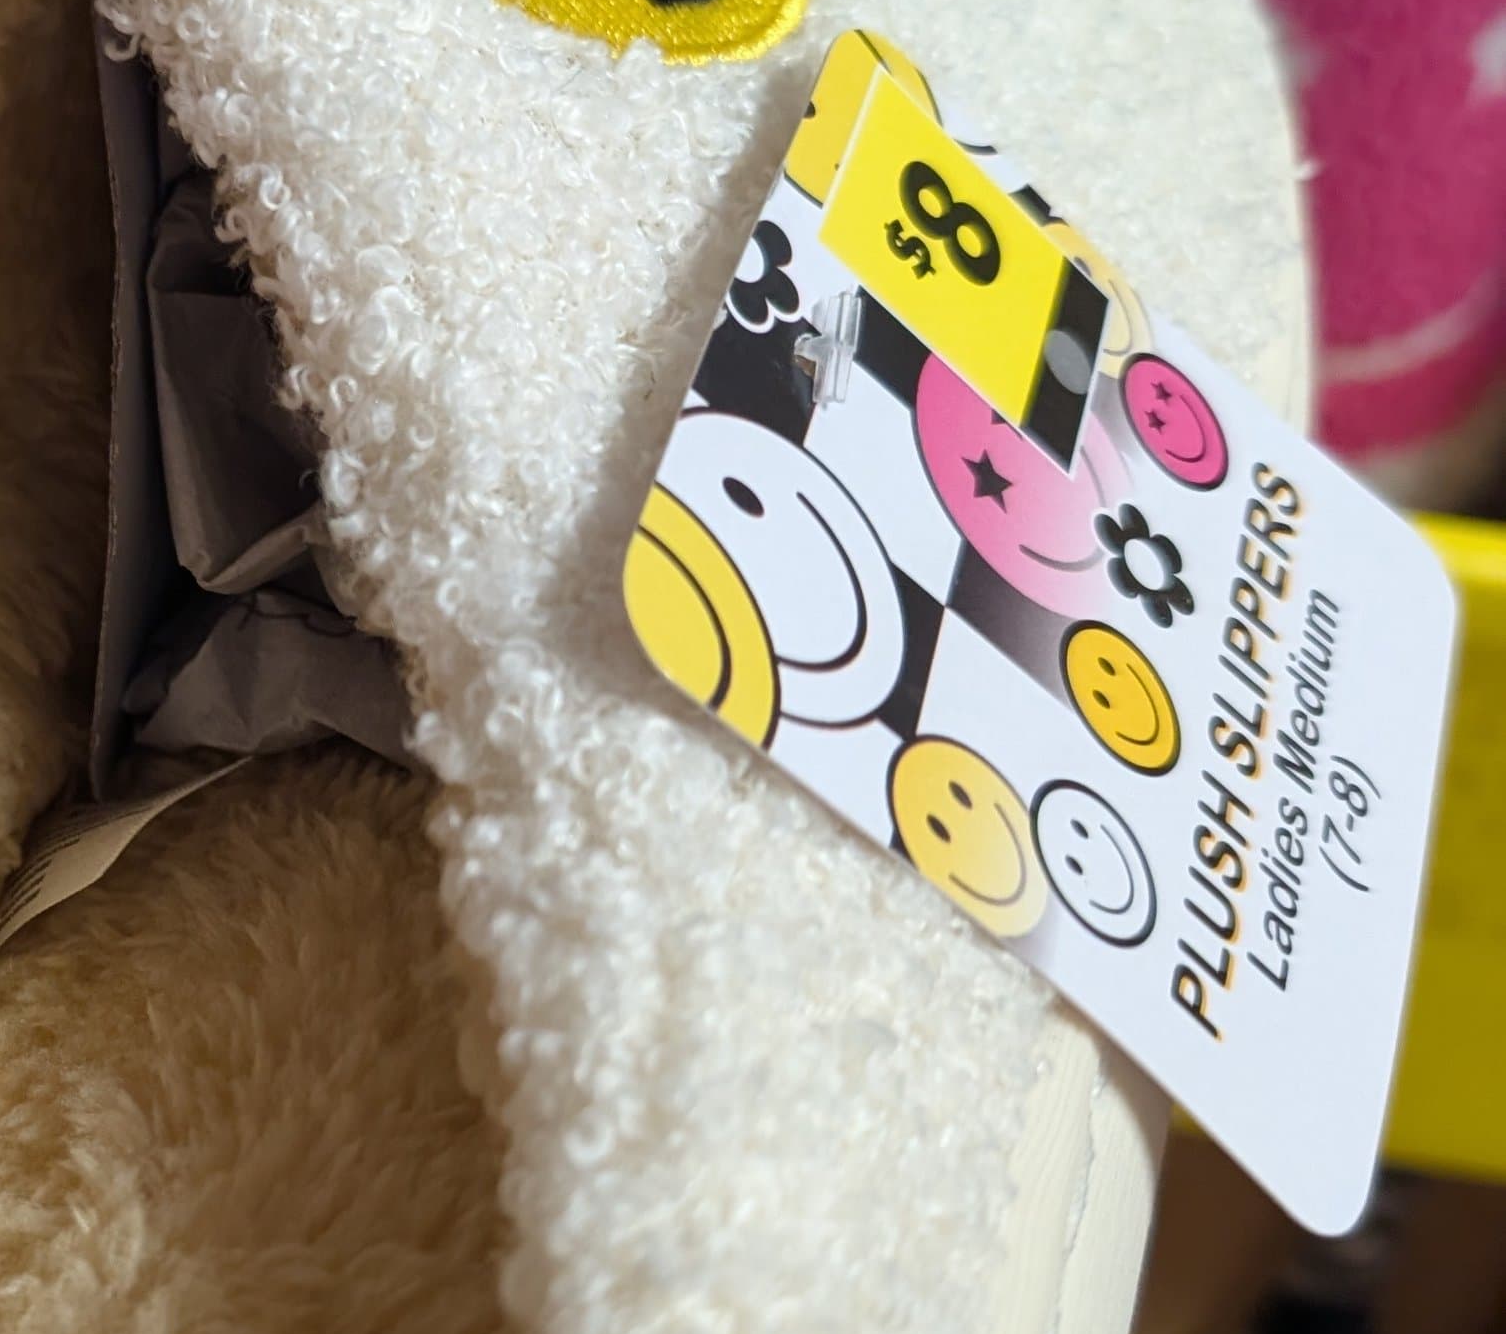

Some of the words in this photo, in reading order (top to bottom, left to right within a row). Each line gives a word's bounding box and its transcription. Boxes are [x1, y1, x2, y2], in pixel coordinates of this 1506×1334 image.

[884, 161, 1001, 286] $8
[1206, 461, 1301, 779] SLIPPERS
[1272, 588, 1340, 795] Medium
[1169, 769, 1253, 1041] PLUSH
[1246, 796, 1309, 992] Ladies
[1319, 754, 1382, 892] (7-8)
